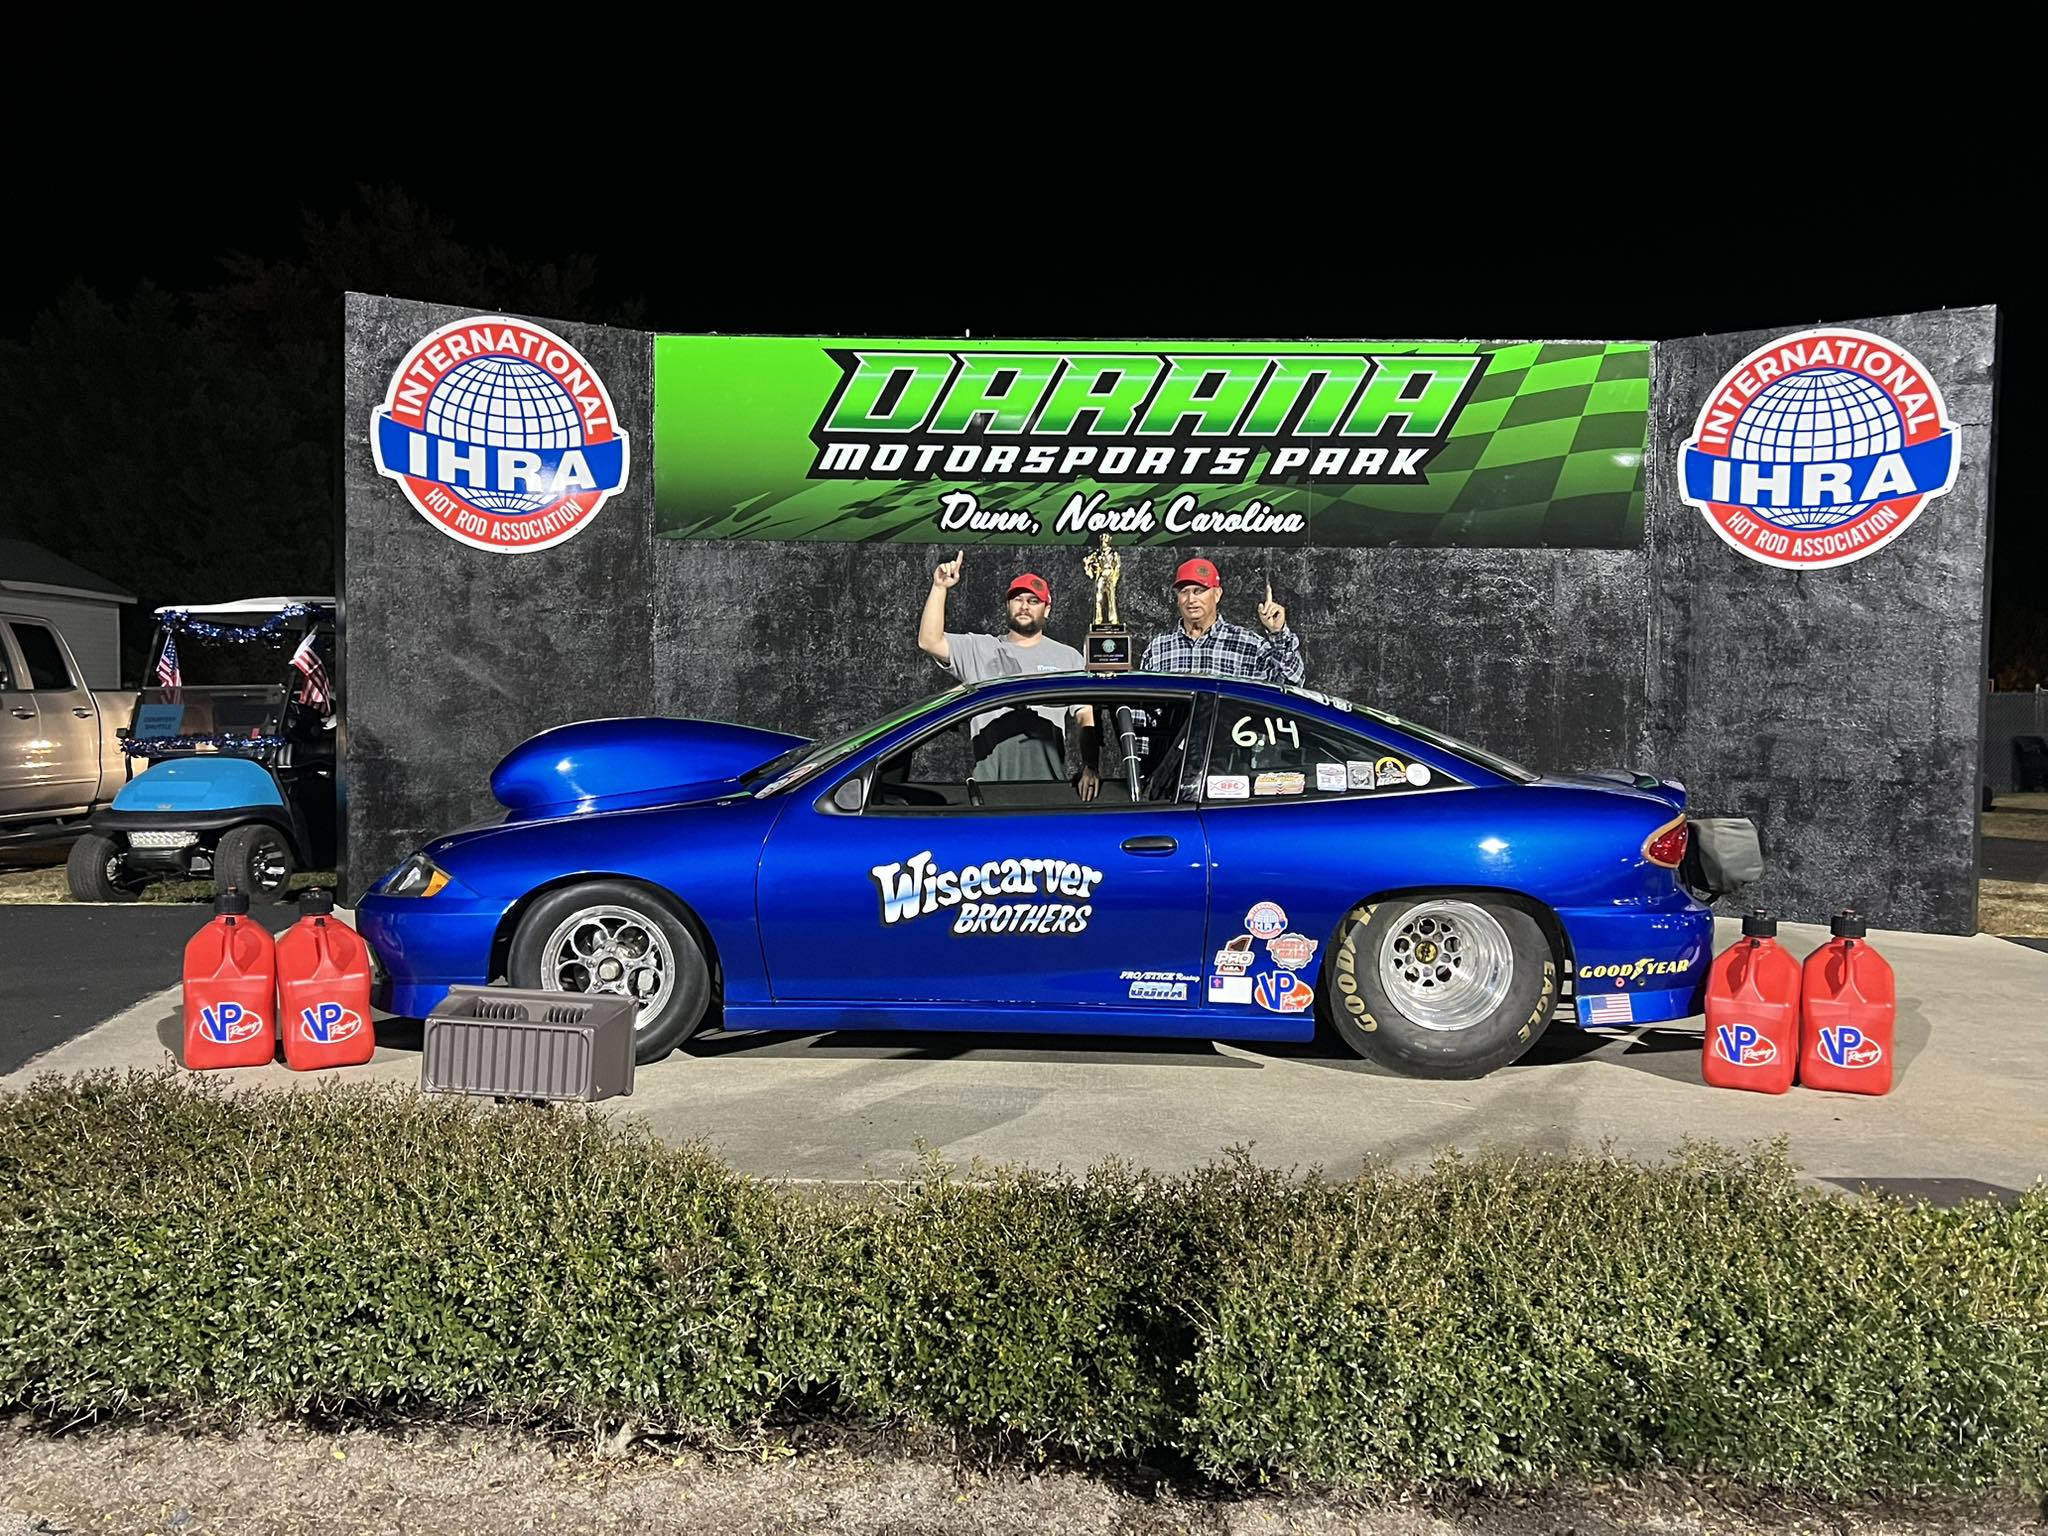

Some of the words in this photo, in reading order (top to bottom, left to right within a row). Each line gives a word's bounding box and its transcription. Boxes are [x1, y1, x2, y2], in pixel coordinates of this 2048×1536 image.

[395, 327, 608, 436] INTERNATIONAL
[823, 352, 1482, 436] DARANA
[1702, 340, 1936, 445] INTERNATIONAL
[408, 431, 597, 493] IHRA
[818, 443, 1252, 476] MOTORSPORTS
[1269, 447, 1430, 476] PARK
[1711, 452, 1918, 507] IHRA
[424, 487, 458, 520] HOT
[455, 510, 488, 537] ROD
[491, 497, 584, 542] ASSOCIATION
[940, 491, 1041, 534] Dunn,
[1056, 493, 1155, 533] North
[1165, 495, 1305, 534] Carolina
[1725, 511, 1759, 538] HOT
[1755, 530, 1788, 555] ROD
[1791, 505, 1899, 557] ASSOCIATION
[1231, 716, 1300, 749] 6.14
[871, 850, 1104, 924] Wisecarver
[953, 903, 1092, 934] BROTHERS
[1258, 972, 1297, 1010] VP
[1517, 960, 1556, 1044] EAGLE
[201, 1002, 243, 1042] VP
[229, 1021, 260, 1038] Racing
[301, 1002, 343, 1042] VP
[331, 1019, 360, 1038] Racing
[1717, 1023, 1758, 1063] VP
[1743, 1047, 1774, 1061] Racing
[1819, 1025, 1864, 1066] VP
[1848, 1050, 1879, 1063] Racing
